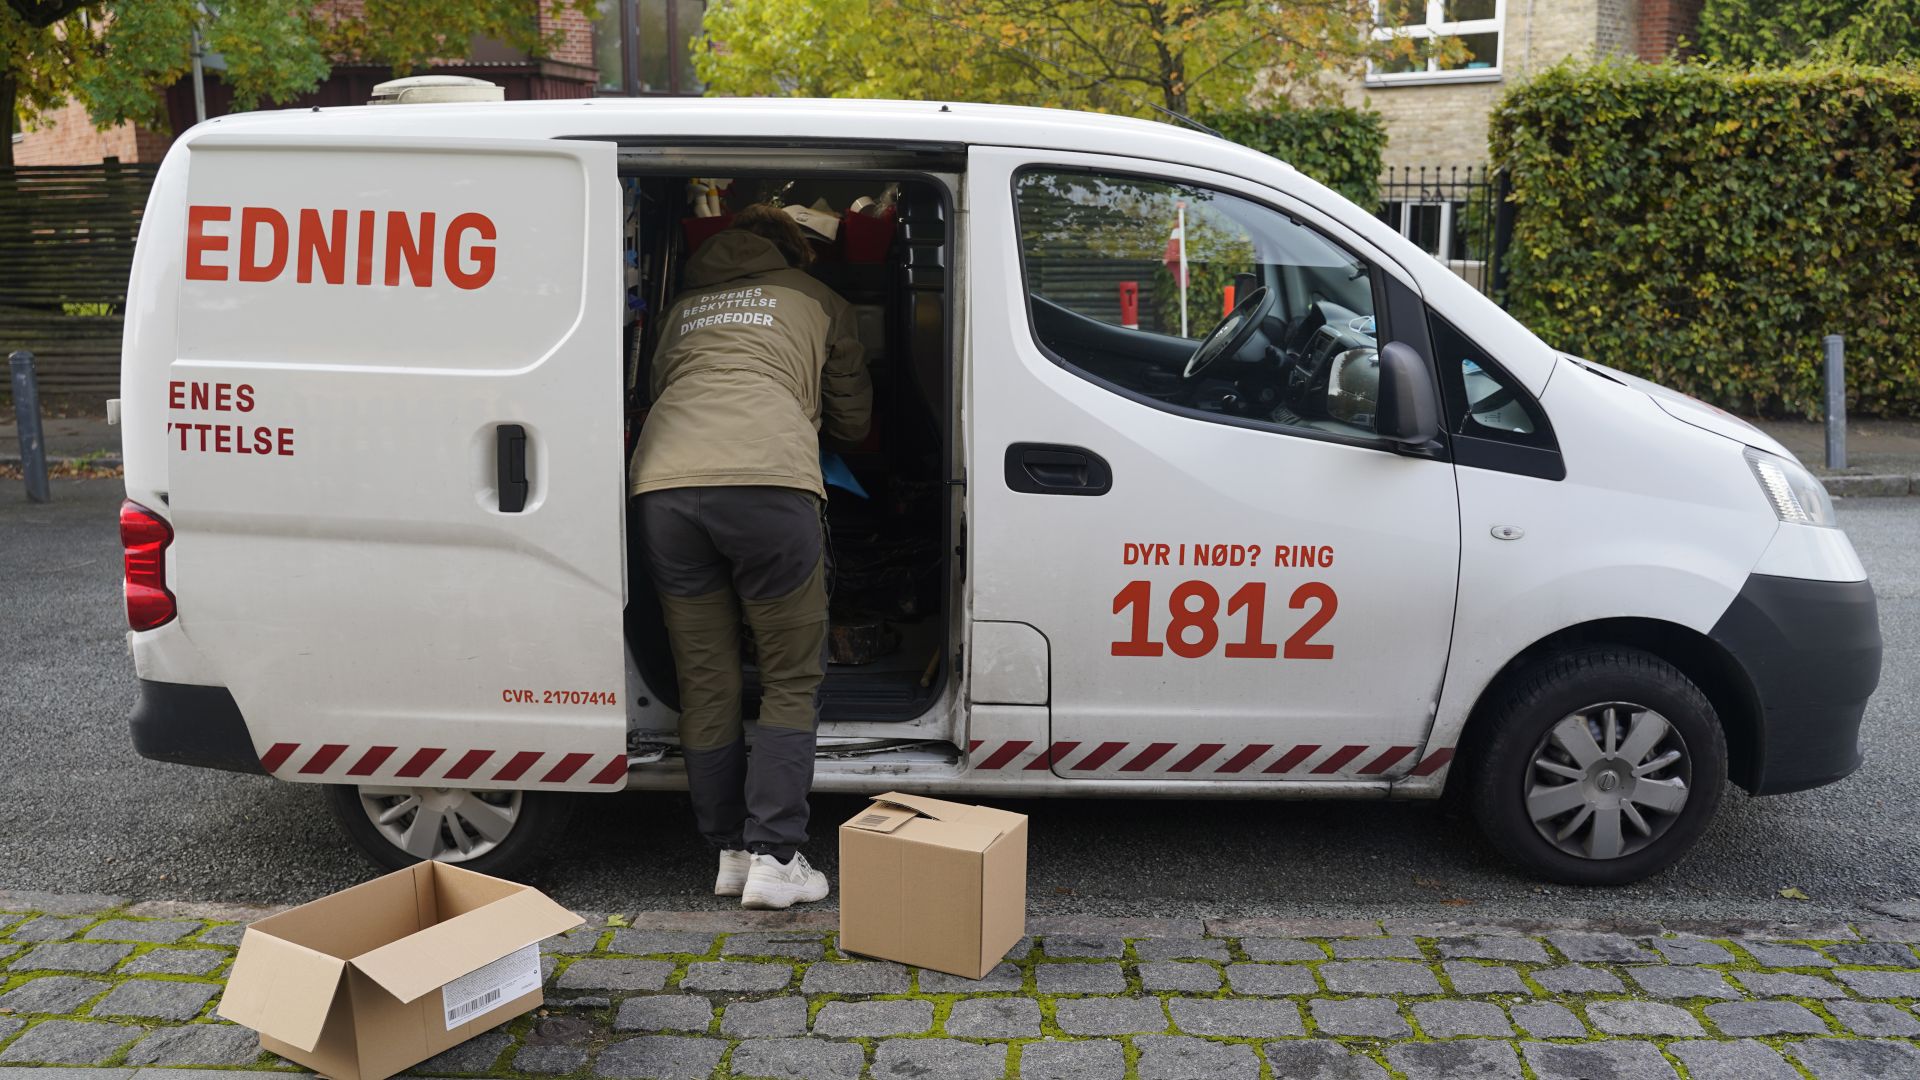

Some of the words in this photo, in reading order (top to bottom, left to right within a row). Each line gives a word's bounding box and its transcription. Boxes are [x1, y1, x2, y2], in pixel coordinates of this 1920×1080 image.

[186, 206, 497, 291] EDNING
[700, 287, 763, 303] DYRENES
[683, 298, 777, 319] BESKYTTELSE
[680, 312, 774, 336] DYREREDDER
[169, 381, 255, 413] ENES
[168, 423, 295, 456] TTELSE
[1123, 543, 1171, 566] DYR
[1178, 543, 1186, 566] I
[1193, 543, 1262, 567] NØD?
[1274, 545, 1335, 568] RING
[1111, 580, 1338, 660] 1812
[502, 689, 540, 703] CVR.
[543, 690, 617, 706] 21707414
